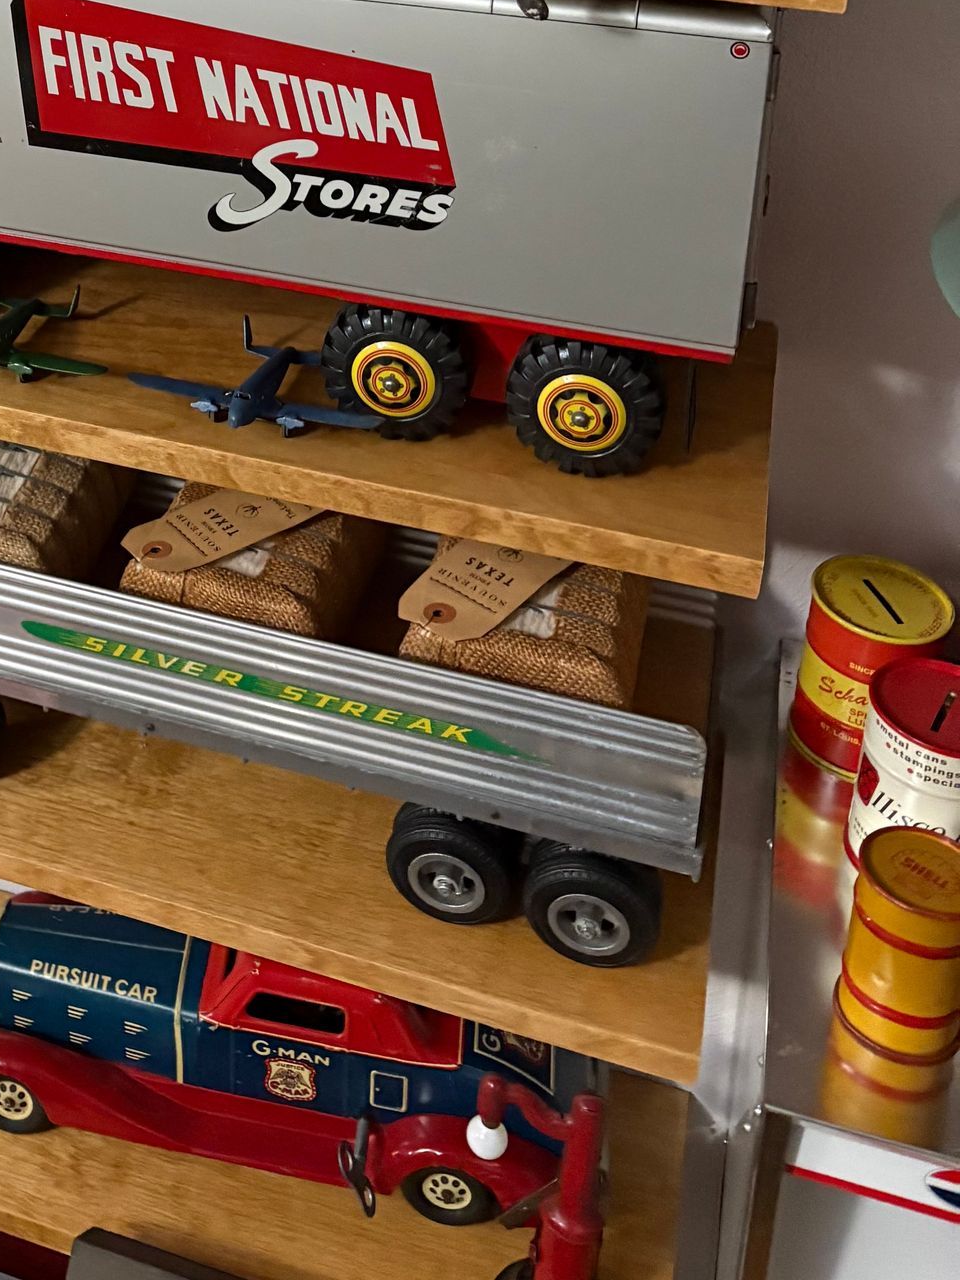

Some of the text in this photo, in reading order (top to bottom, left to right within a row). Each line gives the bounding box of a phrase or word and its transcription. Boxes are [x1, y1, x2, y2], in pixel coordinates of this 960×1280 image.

[37, 24, 440, 153] FIRST NATIONAL
[176, 513, 222, 553] SOUVENIR
[203, 507, 241, 538] TEXAS
[437, 567, 508, 609] SOUVENIR
[464, 556, 515, 588] TEXAS
[81, 635, 473, 744] SILVER STREAK
[880, 723, 948, 766] metal cans
[30, 959, 158, 1003] PURSUIT CAR
